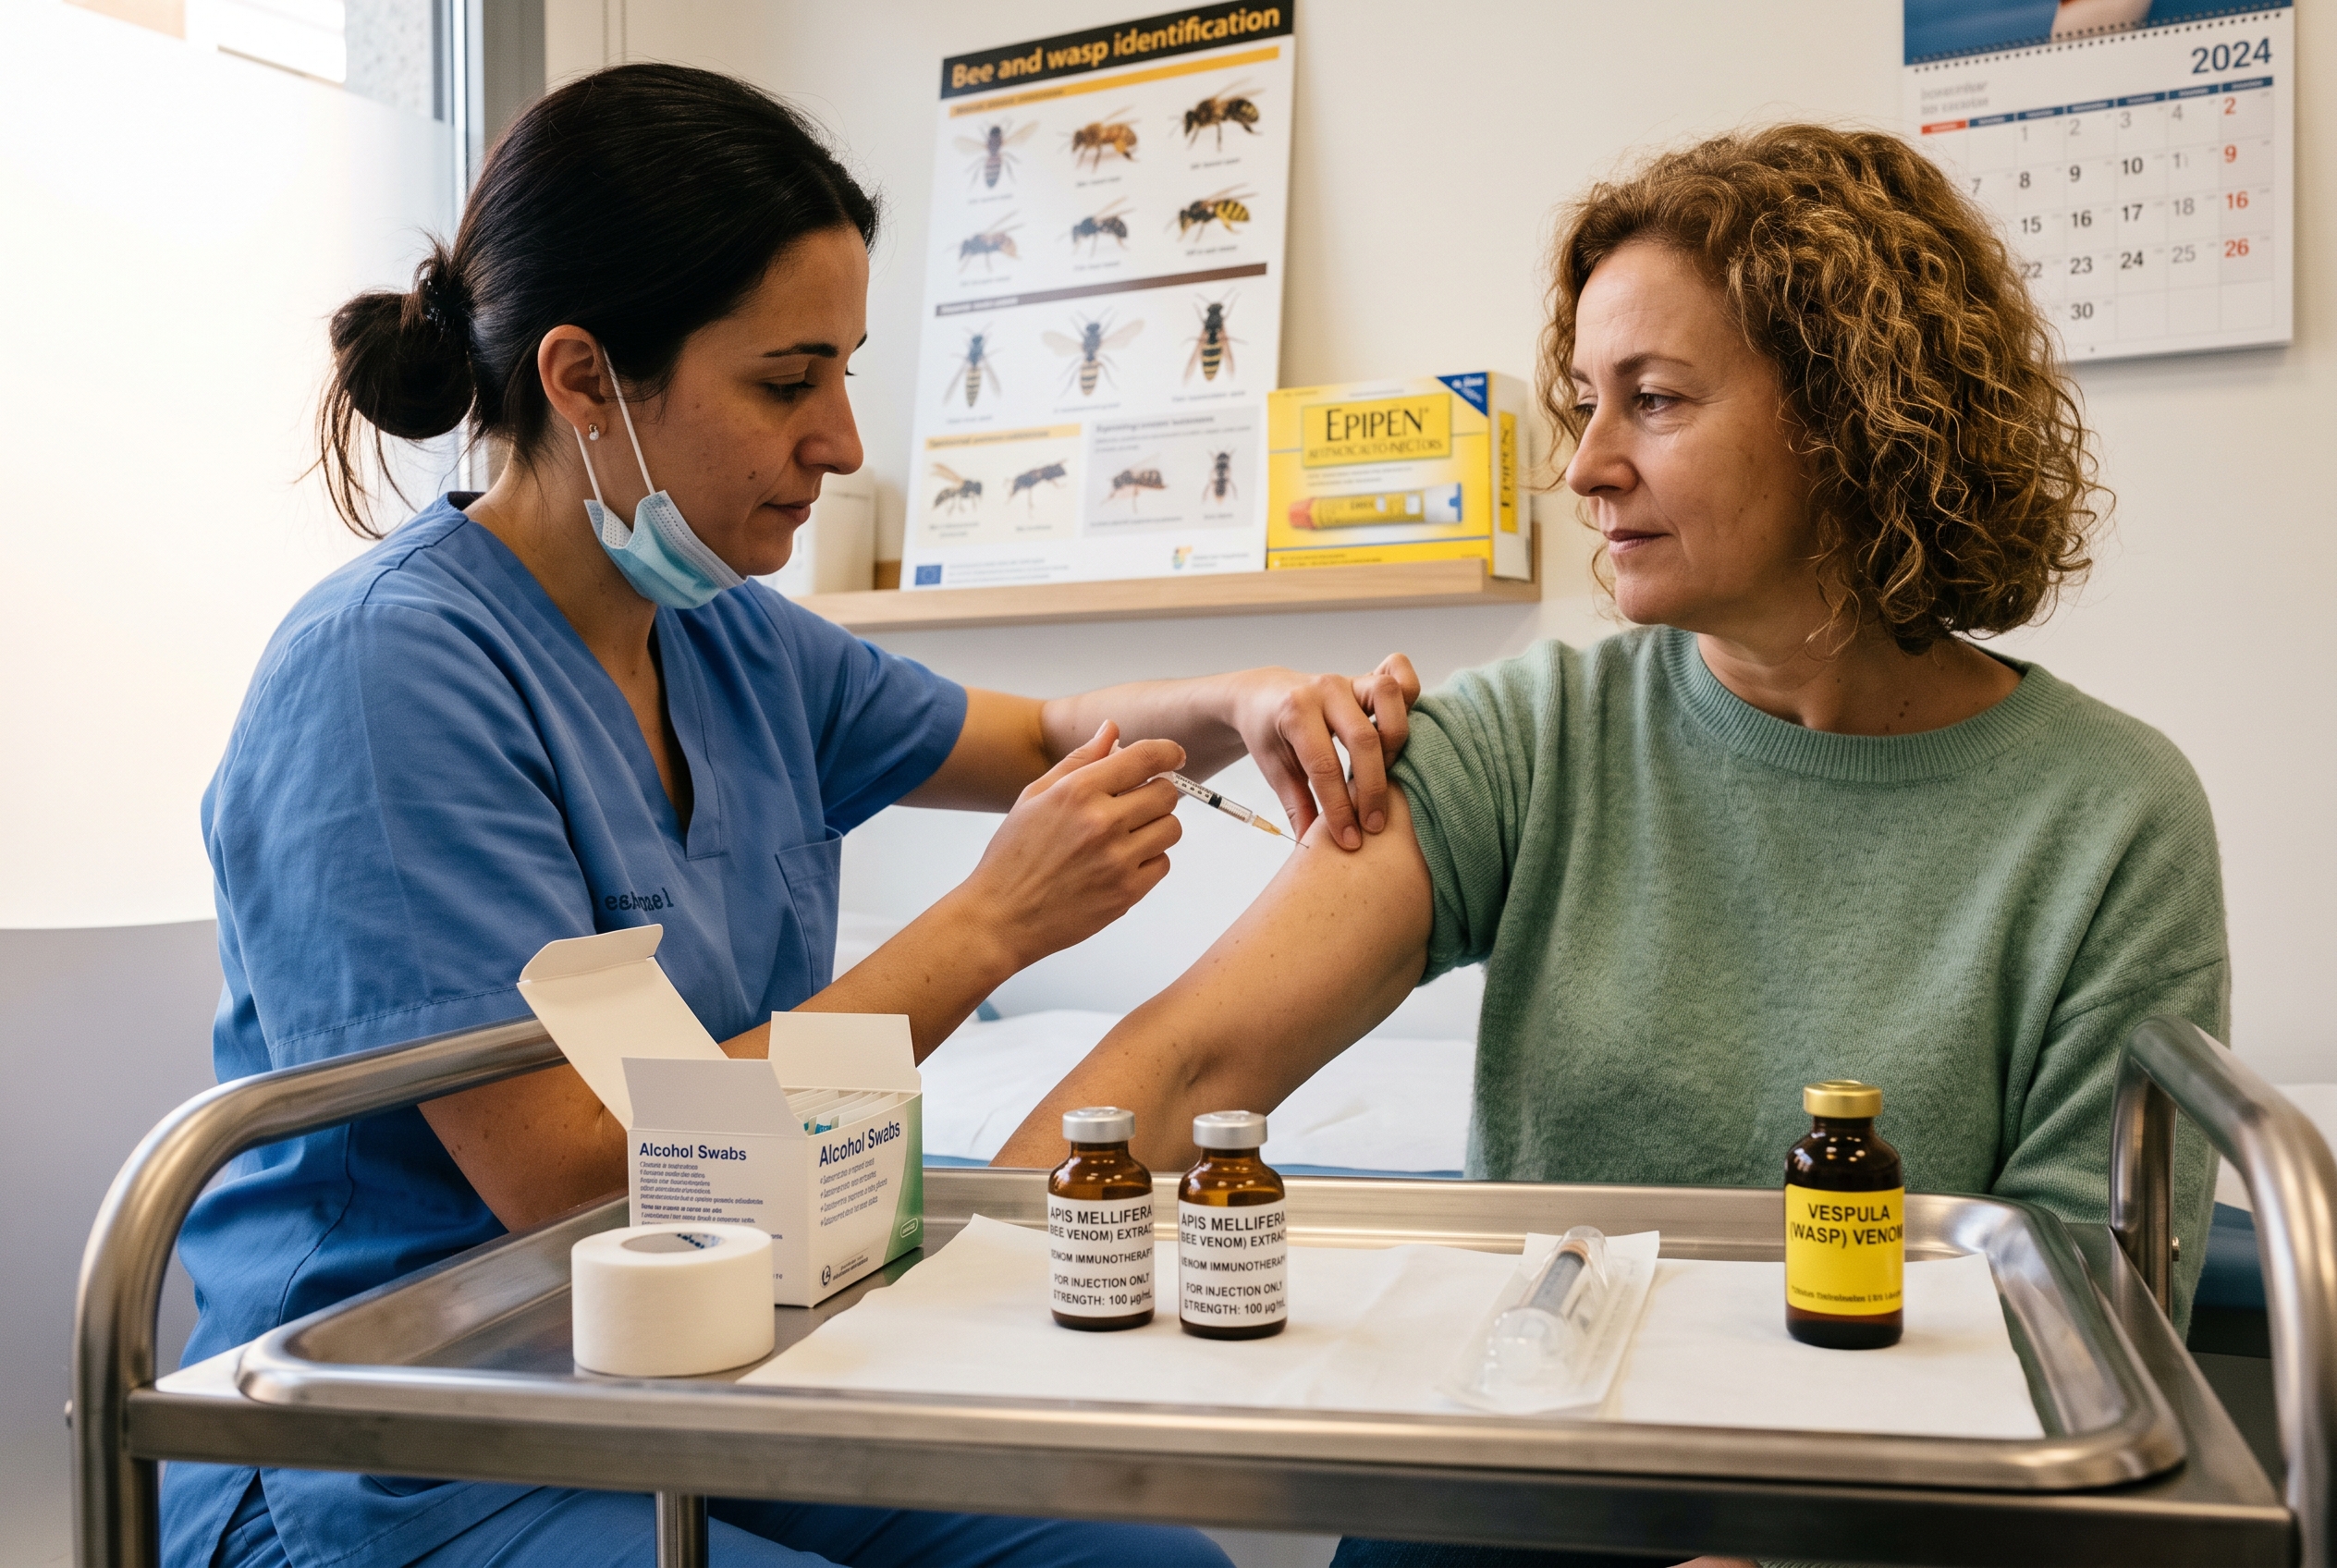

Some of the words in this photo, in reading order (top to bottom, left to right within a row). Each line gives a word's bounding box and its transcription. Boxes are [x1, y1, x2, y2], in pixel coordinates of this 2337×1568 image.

[951, 63, 995, 89] Bee
[997, 46, 1043, 80] and
[1046, 41, 1109, 68] wasp
[1113, 7, 1281, 57] identification
[2191, 37, 2272, 75] 2024
[2069, 117, 2081, 136] 2
[2120, 111, 2132, 129] 3
[2172, 104, 2183, 121] 4
[2223, 96, 2236, 116] 2
[2019, 171, 2031, 189] 8
[2069, 165, 2081, 183] 9
[2123, 157, 2144, 175] 10
[2224, 144, 2237, 164] 9
[2021, 215, 2041, 234] 15
[2072, 210, 2092, 228] 16
[2122, 202, 2143, 222] 17
[2173, 197, 2195, 216] 18
[2226, 190, 2249, 210] 16
[2070, 256, 2093, 275] 23
[2121, 250, 2144, 269] 24
[2172, 245, 2196, 264] 25
[2224, 238, 2249, 258] 26
[2071, 302, 2093, 320] 30
[640, 1142, 693, 1158] Alcohol
[698, 1145, 747, 1161] Swabs
[819, 1132, 864, 1167] Alcohol
[868, 1121, 900, 1148] Swabs
[1050, 1207, 1072, 1223] APIS
[1077, 1205, 1152, 1224] MELLIFERA
[1181, 1213, 1206, 1231] APIS
[1211, 1210, 1286, 1231] MELLIFERA
[1807, 1202, 1890, 1222] VESPULA
[1066, 1229, 1113, 1243] VENOM)
[1199, 1235, 1247, 1250] VENOM)
[1790, 1220, 1848, 1249] (WASP)
[1071, 1277, 1127, 1289] INJECTION
[1186, 1281, 1203, 1295] FOR
[1205, 1285, 1261, 1297] INJECTION
[1264, 1280, 1283, 1294] ONLY
[1109, 1294, 1127, 1305] 100
[1244, 1303, 1262, 1314] 100
